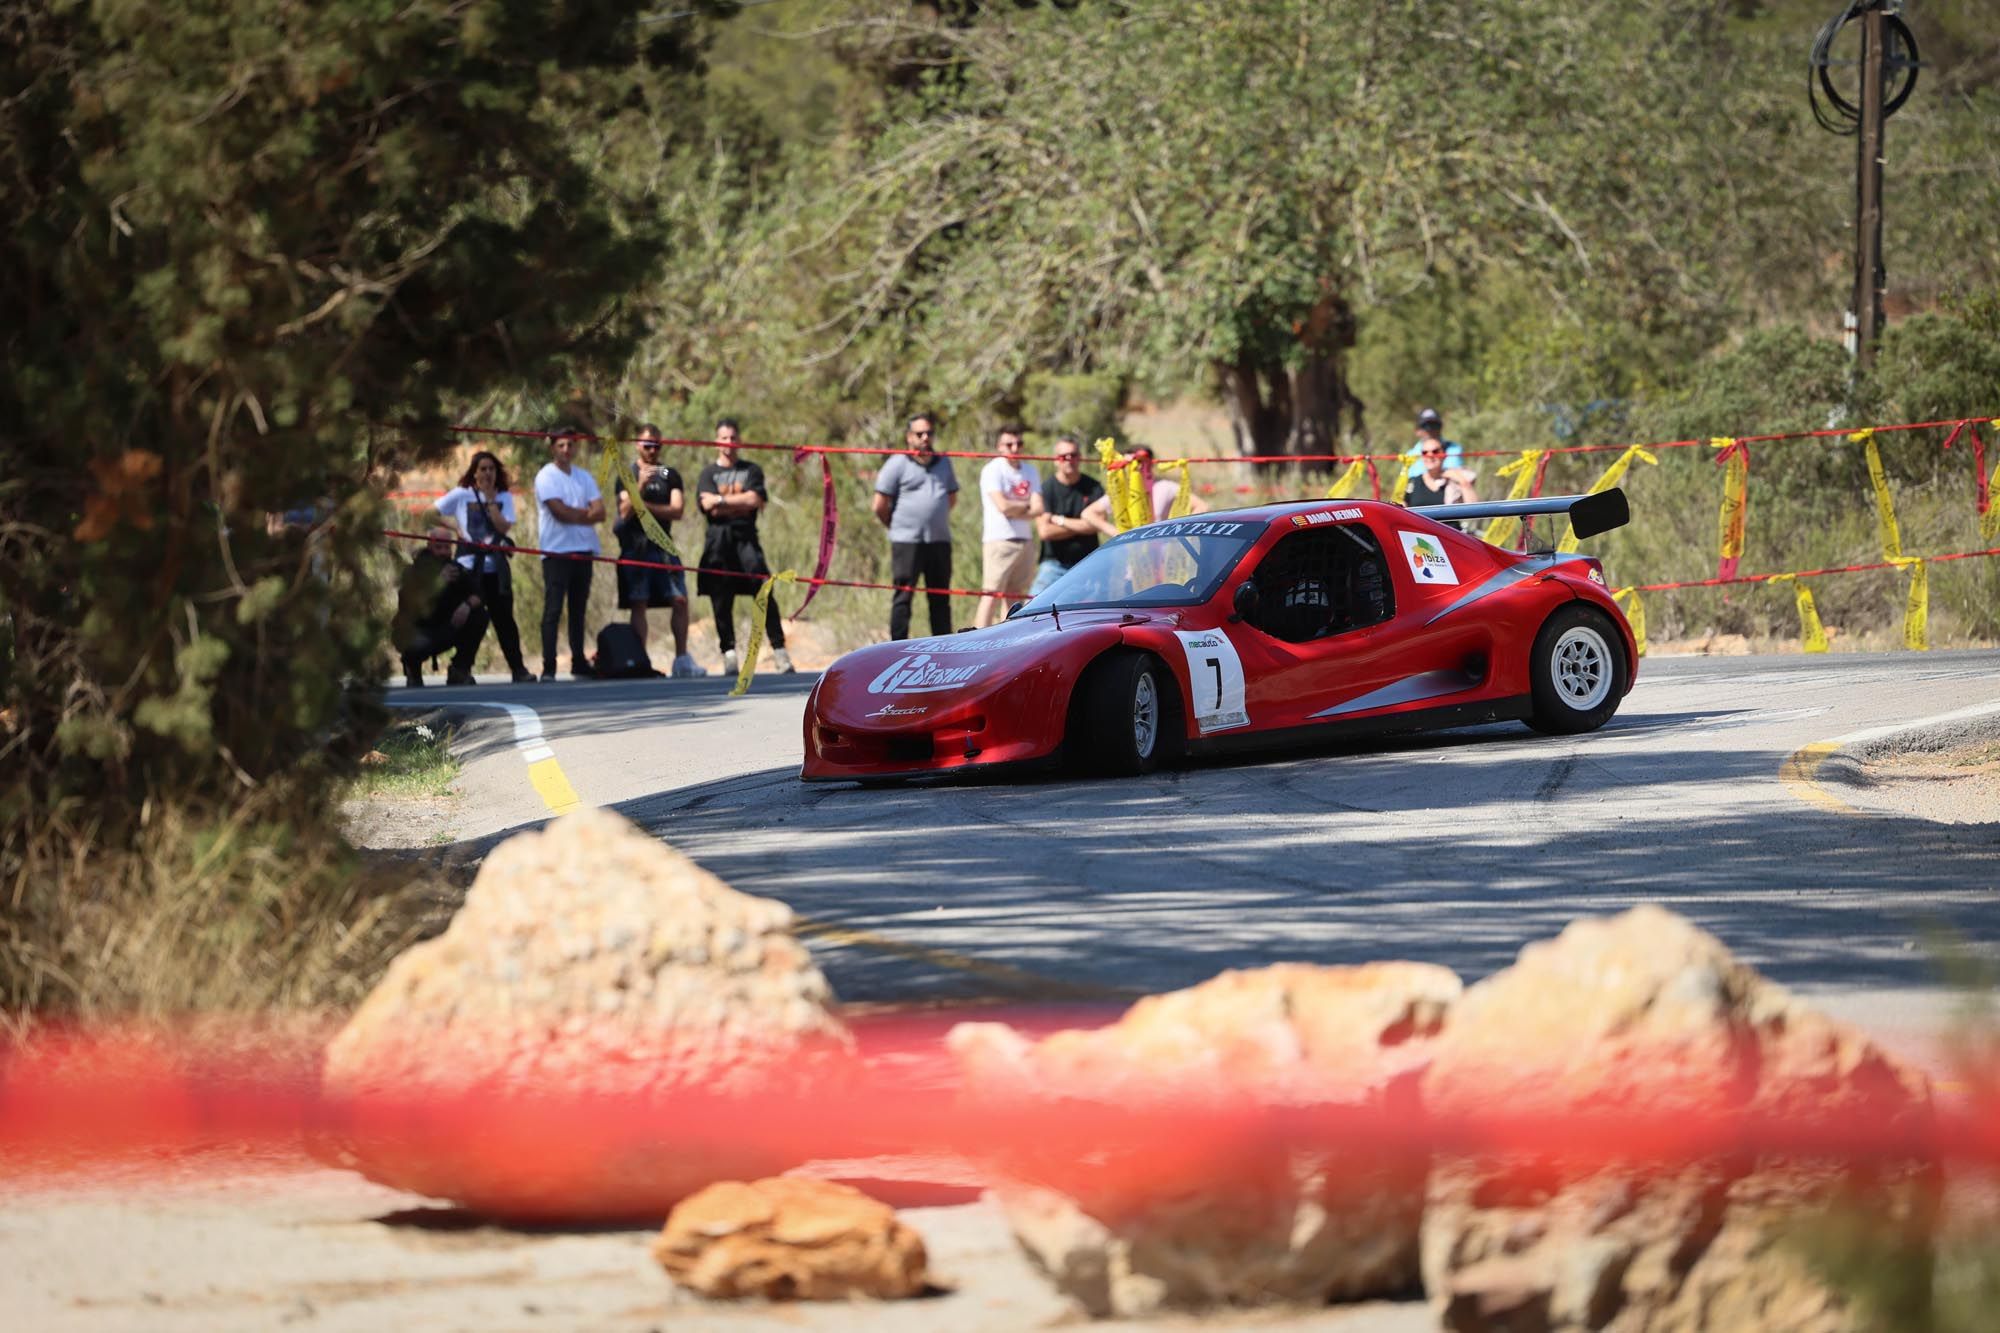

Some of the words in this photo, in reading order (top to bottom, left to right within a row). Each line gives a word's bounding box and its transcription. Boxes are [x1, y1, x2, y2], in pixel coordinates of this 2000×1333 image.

[1332, 508, 1363, 520] BERNAT
[1141, 522, 1243, 539] CANTATI
[1423, 553, 1446, 563] Ibiza
[1189, 640, 1218, 648] mecauto
[1206, 658, 1222, 709] 7
